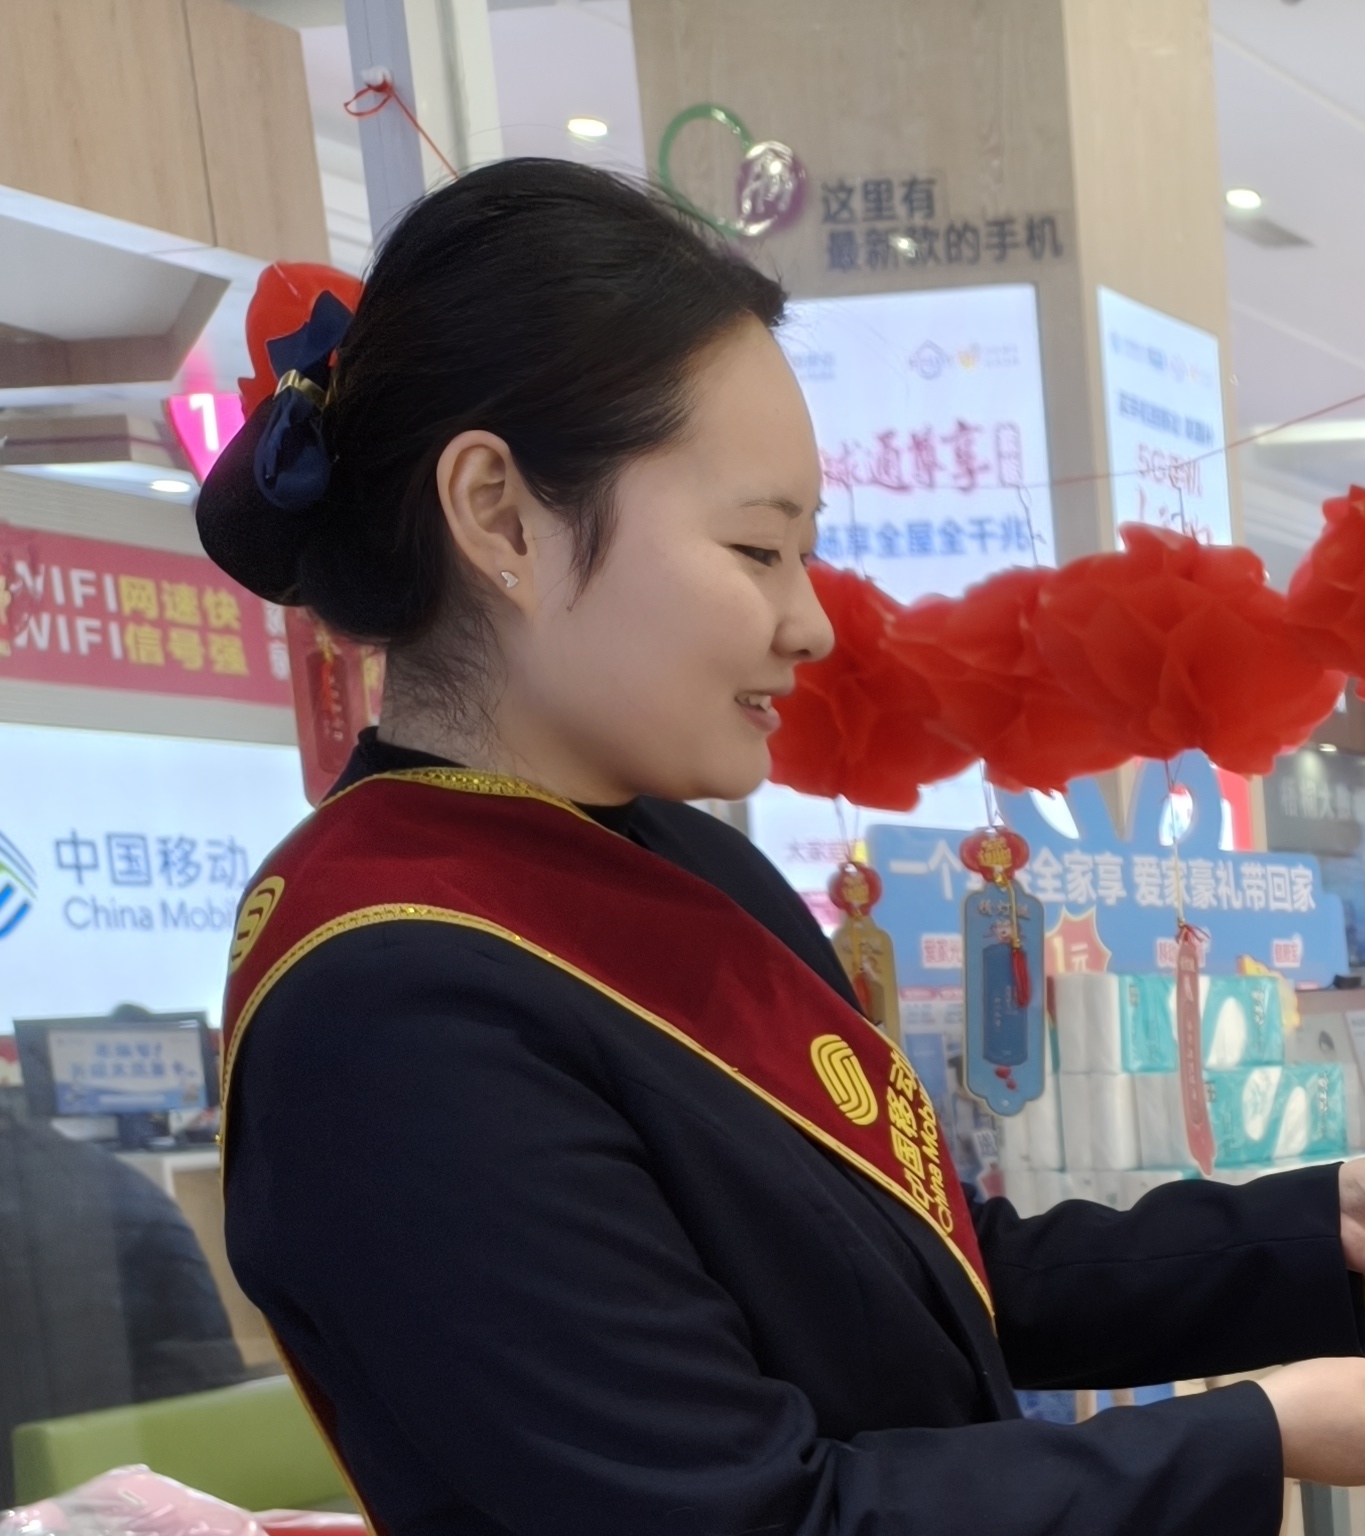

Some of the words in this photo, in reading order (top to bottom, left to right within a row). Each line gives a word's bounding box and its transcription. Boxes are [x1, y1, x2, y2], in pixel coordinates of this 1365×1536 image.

[820, 177, 938, 226] 这里有
[825, 215, 1064, 272] 最新款的手机
[54, 829, 250, 890] 中国移动
[64, 896, 154, 932] China
